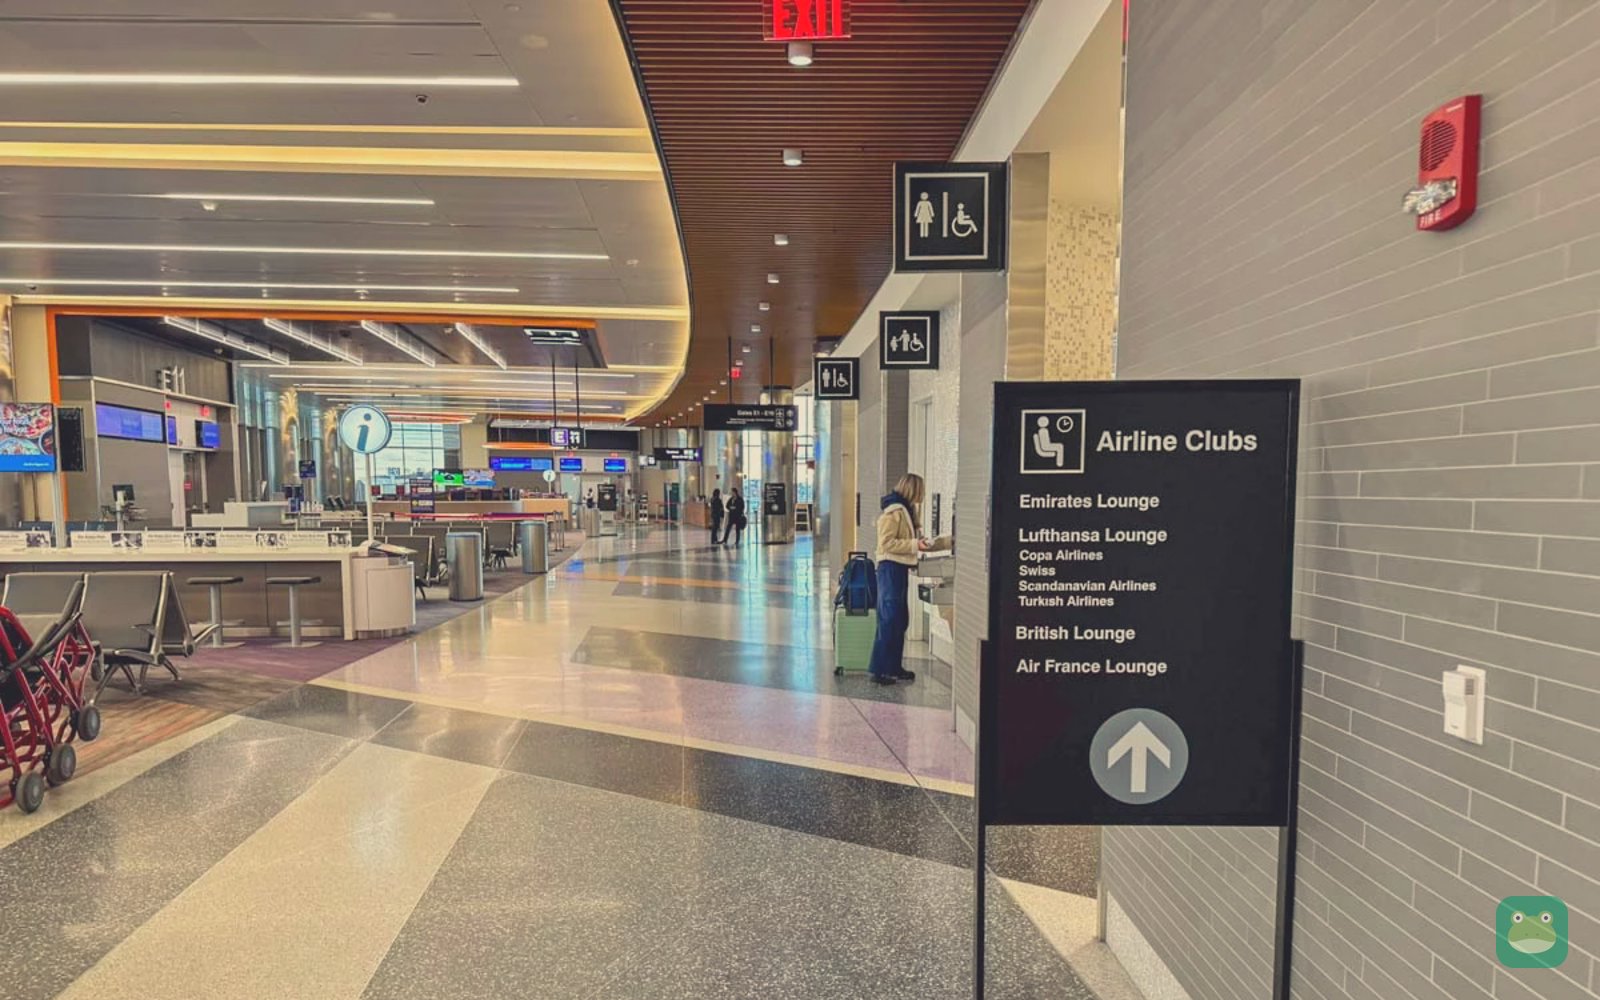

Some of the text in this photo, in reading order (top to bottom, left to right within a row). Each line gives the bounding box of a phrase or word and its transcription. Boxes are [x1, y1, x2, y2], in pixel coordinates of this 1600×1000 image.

[773, 0, 842, 38] EXIT
[554, 431, 564, 443] E
[1097, 430, 1257, 451] Airline Clubs
[1020, 494, 1159, 511] Emirates Lounge
[1020, 528, 1167, 545] Lufthansa Lounge
[1020, 550, 1103, 563] Copa Airlines
[1020, 565, 1055, 576] Swiss
[1019, 580, 1156, 591] Scandanavian Airlines
[1019, 596, 1114, 606] Turkish Airlines
[1016, 626, 1135, 643] British Lounge
[1017, 659, 1167, 676] Air France Lounge
